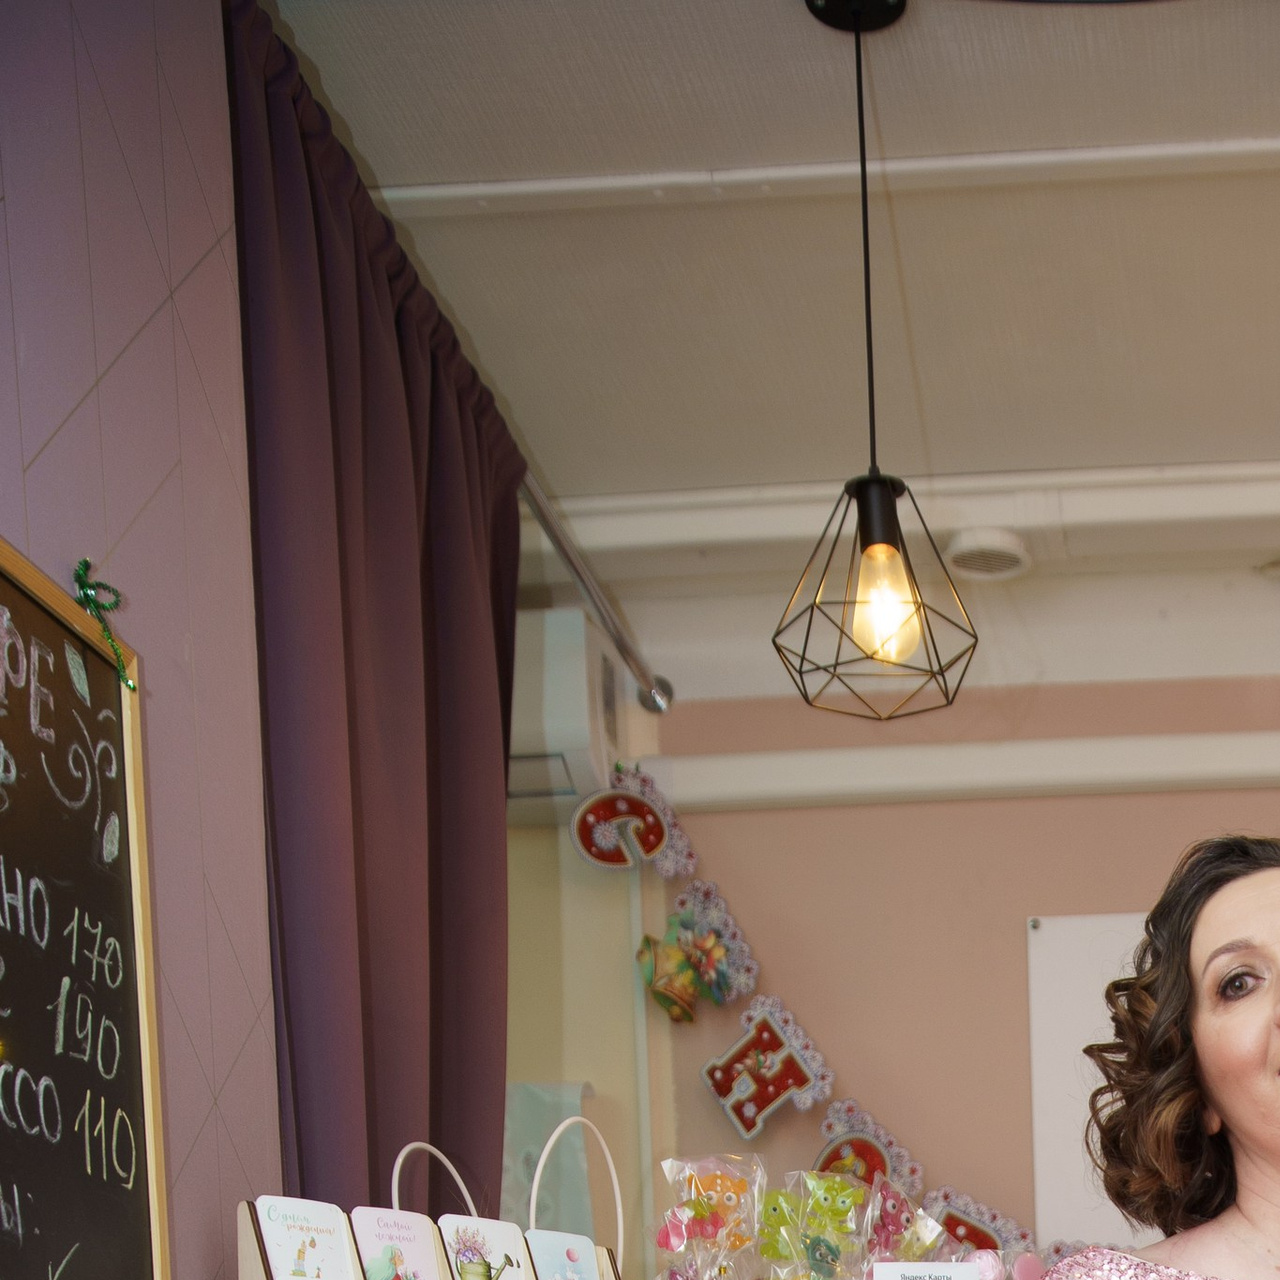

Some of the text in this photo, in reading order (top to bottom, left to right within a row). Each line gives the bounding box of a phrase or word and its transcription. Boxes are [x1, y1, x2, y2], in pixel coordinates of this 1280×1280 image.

[63, 904, 123, 989] 170
[46, 975, 120, 1079] 190
[74, 1088, 137, 1190] 110
